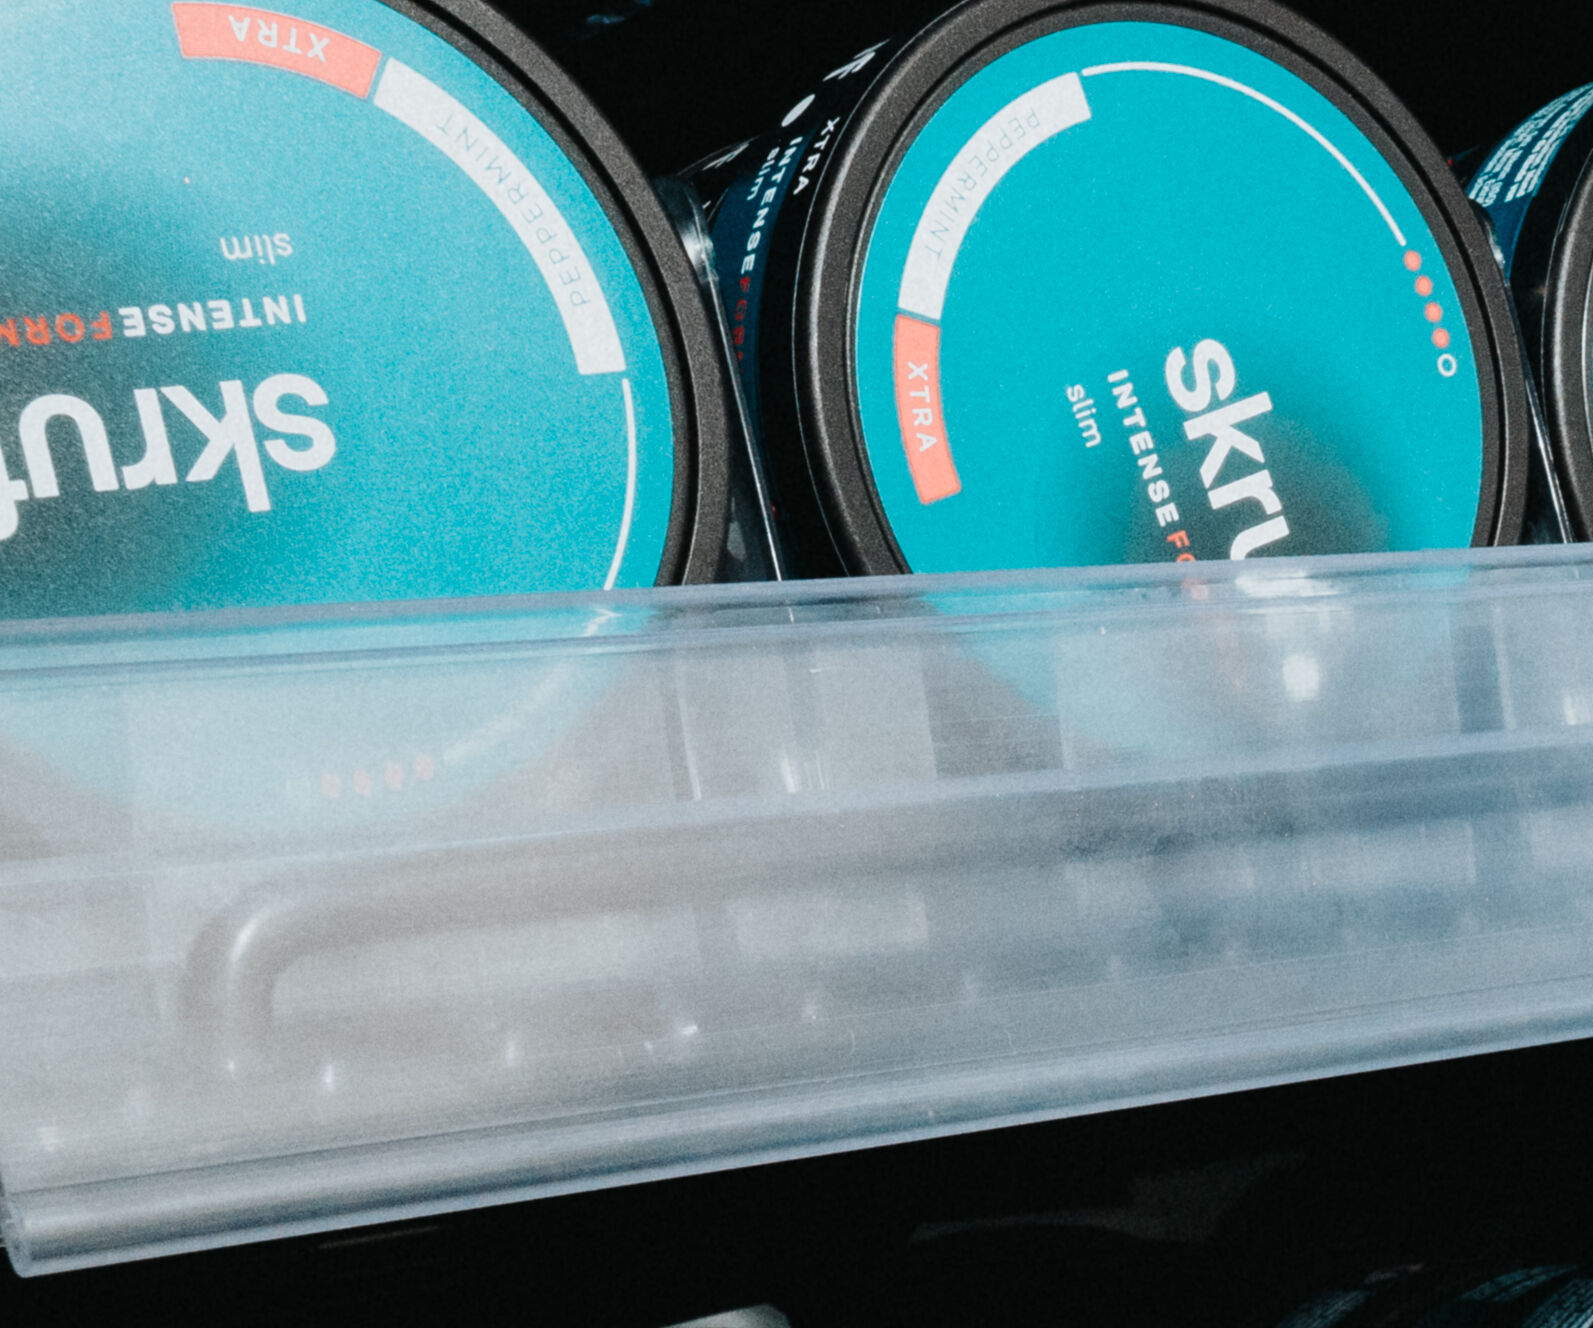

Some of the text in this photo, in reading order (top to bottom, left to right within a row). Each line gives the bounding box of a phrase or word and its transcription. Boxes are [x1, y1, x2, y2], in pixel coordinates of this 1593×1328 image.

[229, 15, 330, 62] XTRA
[793, 115, 841, 196] XTRA
[926, 107, 1041, 261] PEPPERMINT
[432, 112, 588, 308] PEPPERMINT
[220, 232, 293, 266] slim
[0, 311, 113, 348] FORM
[906, 360, 937, 453] XTRA
[1065, 383, 1102, 449] slim
